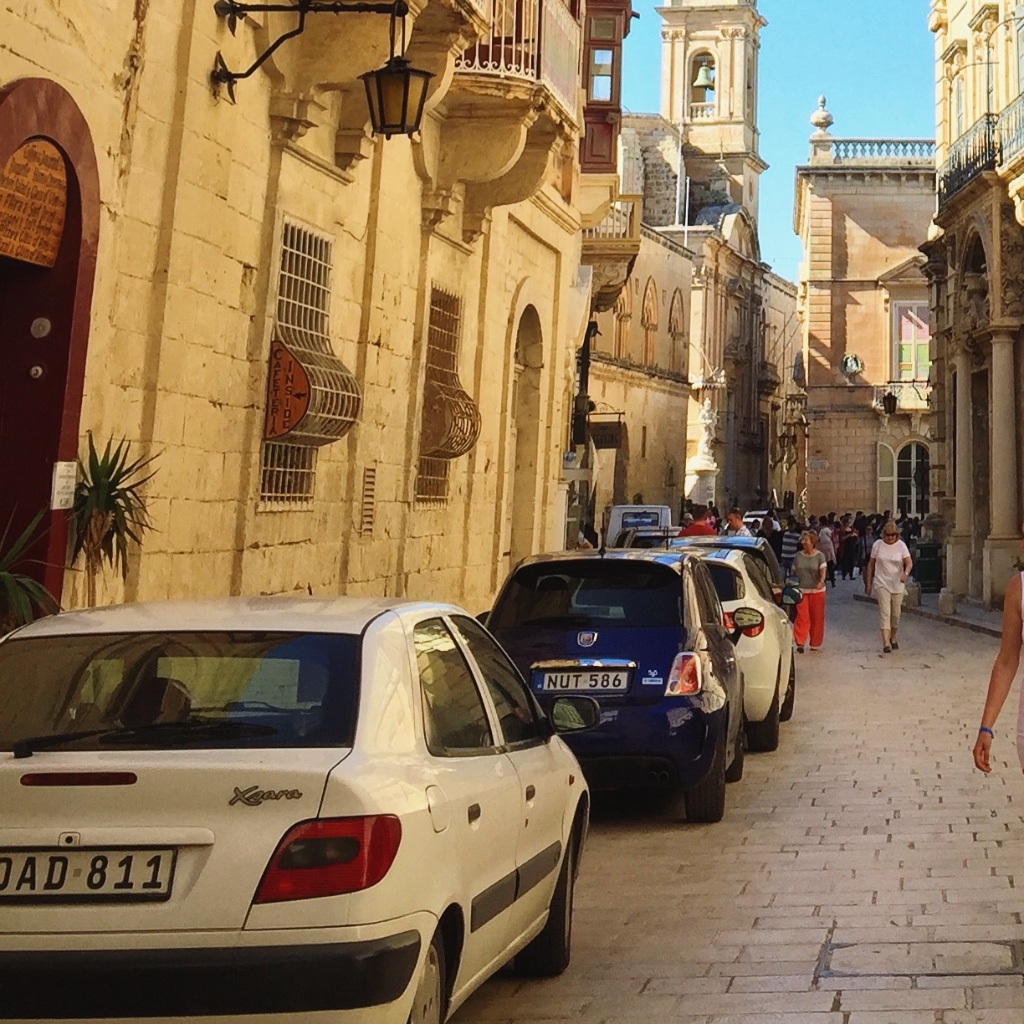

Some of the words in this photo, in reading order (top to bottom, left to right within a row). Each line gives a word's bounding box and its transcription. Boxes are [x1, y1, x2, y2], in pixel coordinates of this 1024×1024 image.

[270, 349, 283, 435] CAFETERIA
[283, 361, 294, 429] INSIDE
[547, 674, 582, 689] NUT
[588, 673, 622, 688] 586
[86, 854, 162, 890] 811
